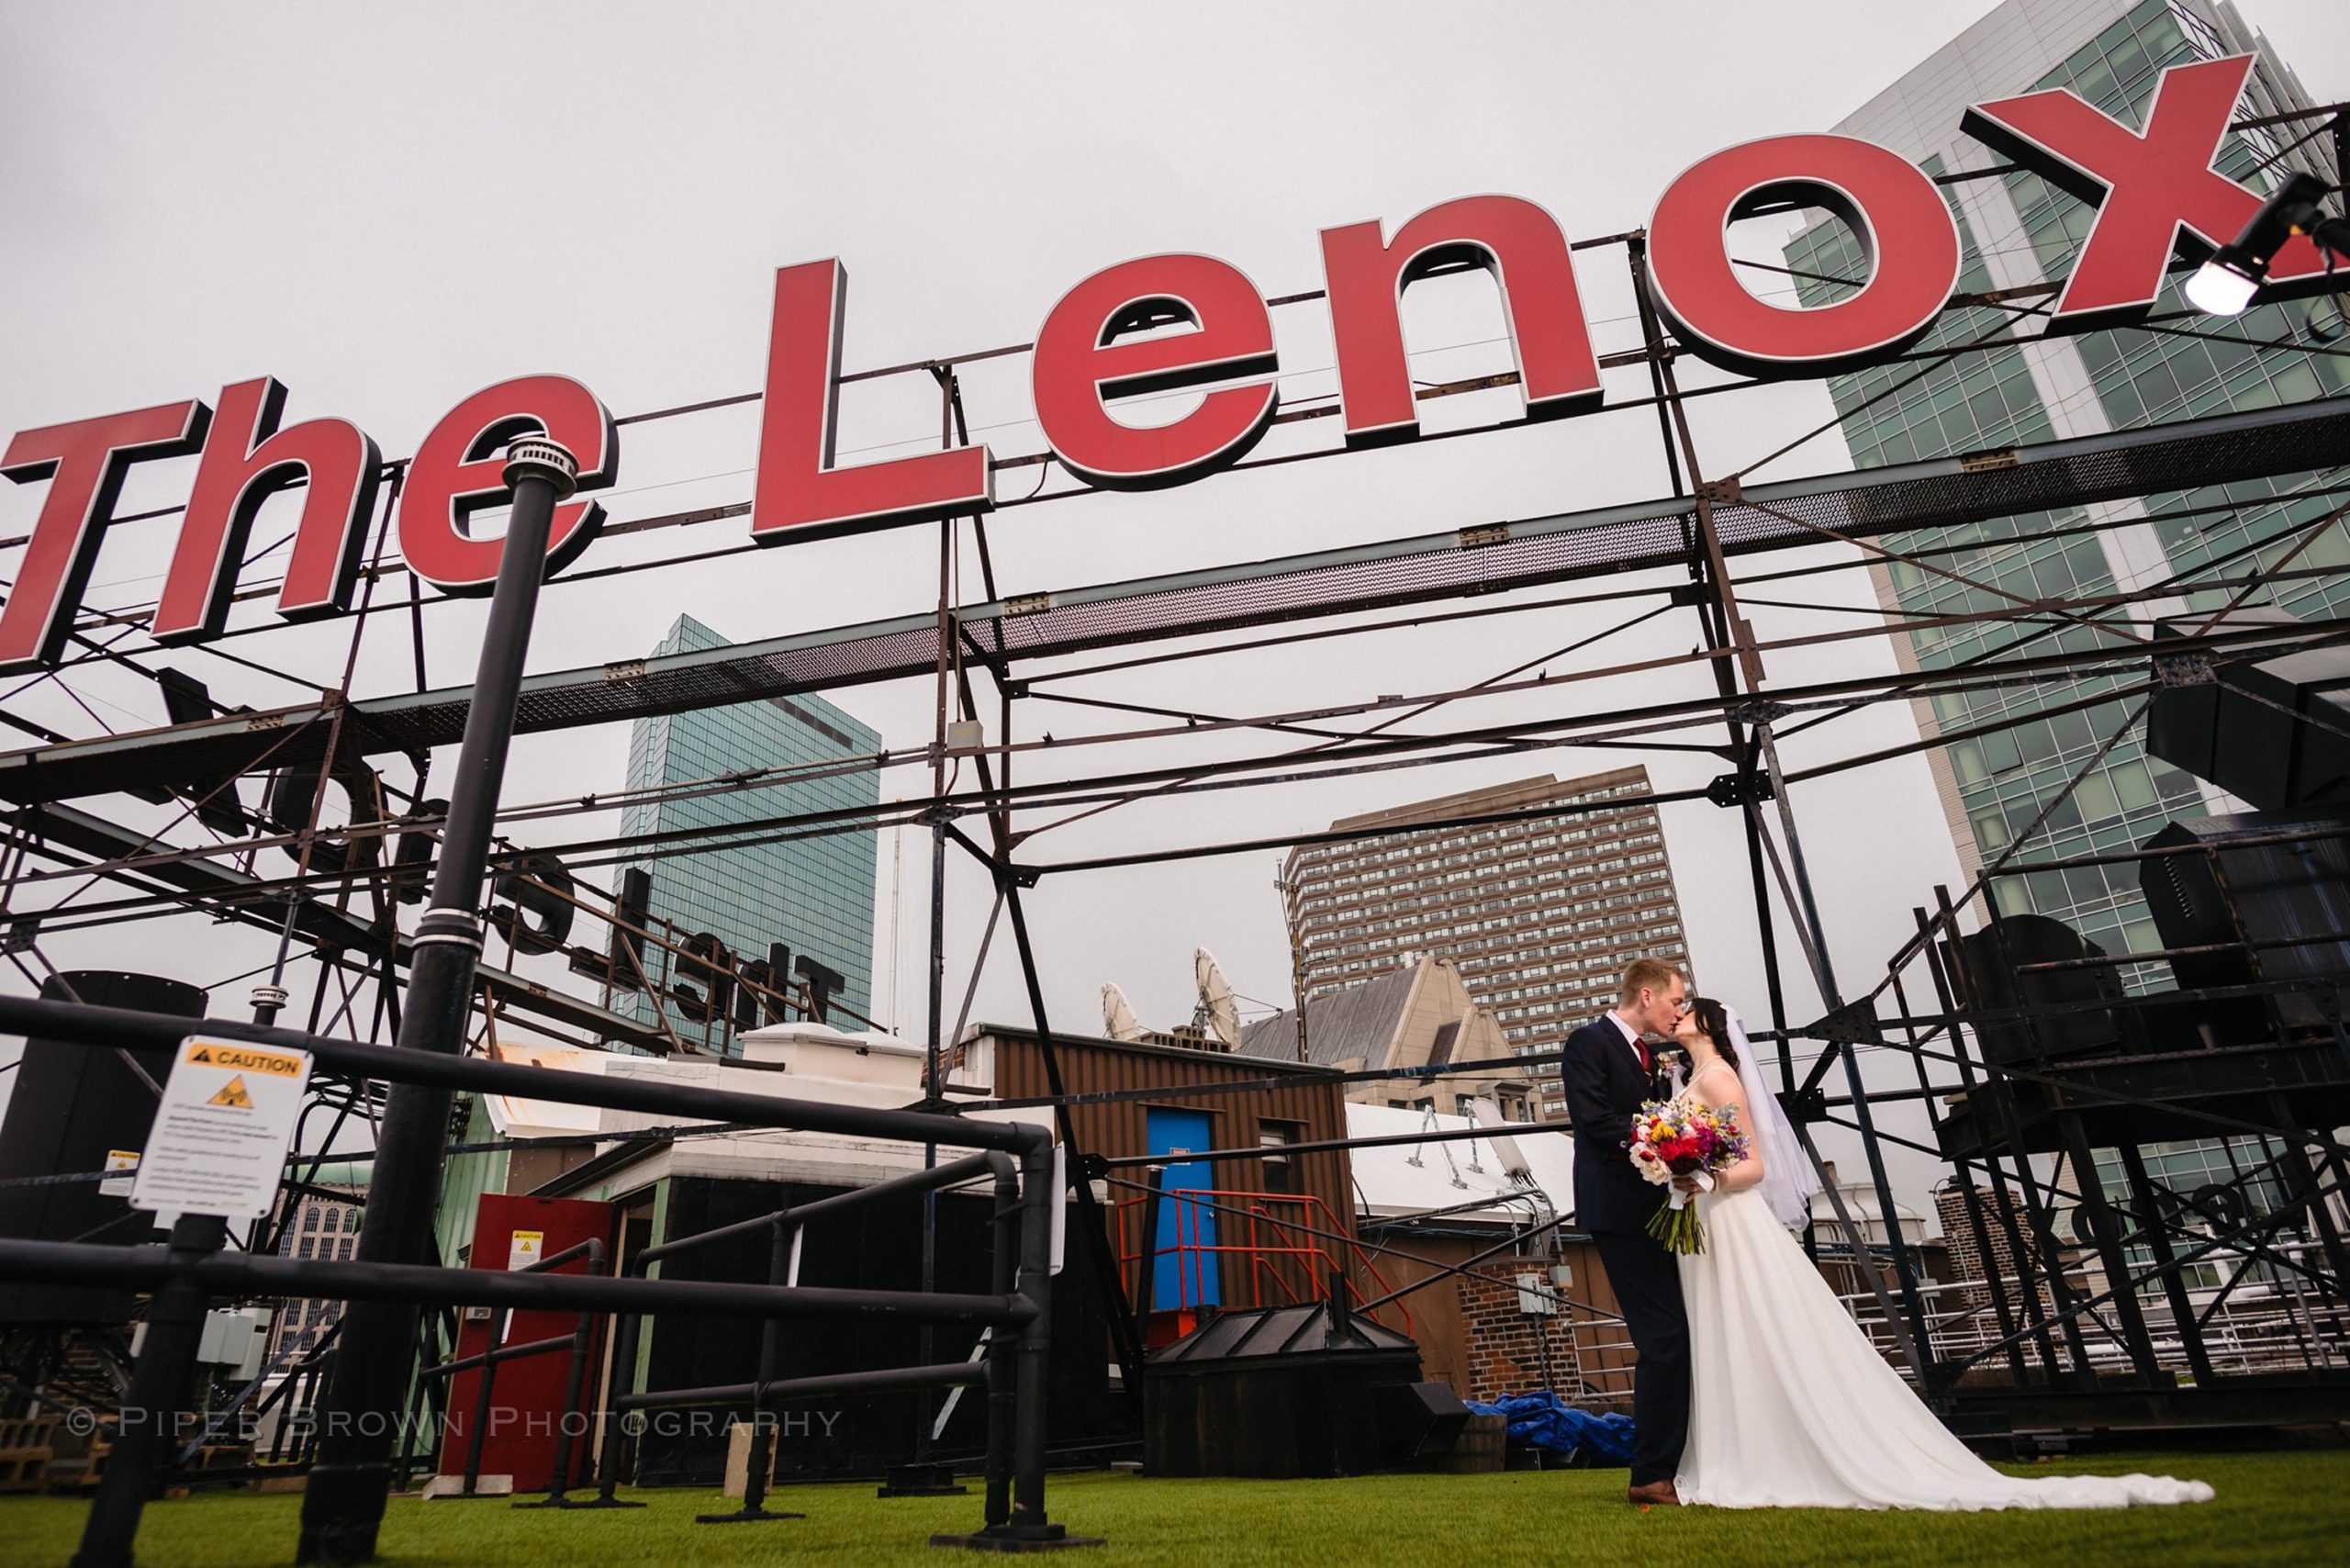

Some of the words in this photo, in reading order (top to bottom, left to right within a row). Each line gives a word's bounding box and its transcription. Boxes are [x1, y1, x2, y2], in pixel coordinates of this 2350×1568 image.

[0, 372, 618, 676] The
[749, 51, 2350, 548] Lenox
[217, 1050, 299, 1074] CAUTION
